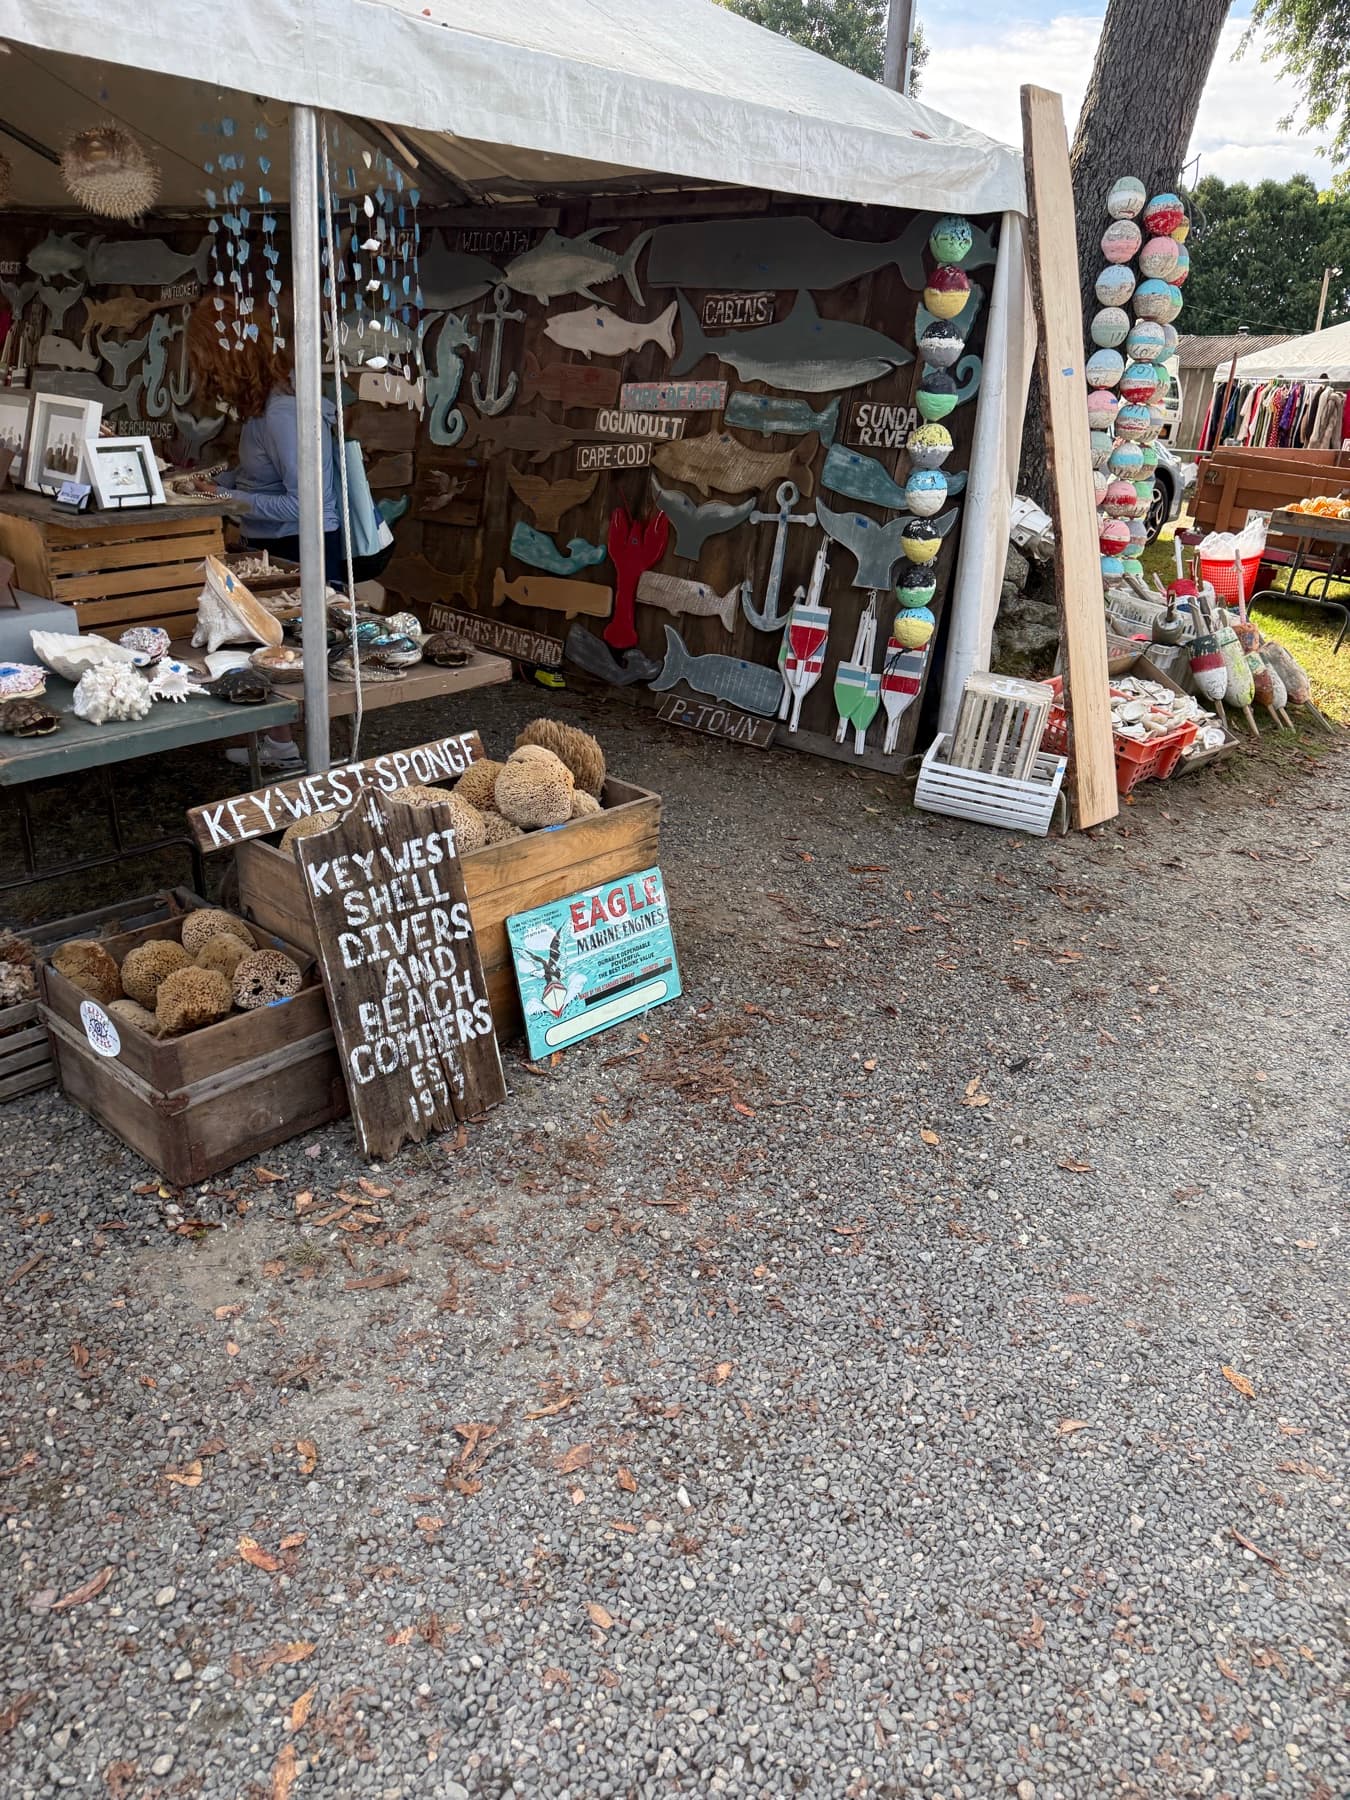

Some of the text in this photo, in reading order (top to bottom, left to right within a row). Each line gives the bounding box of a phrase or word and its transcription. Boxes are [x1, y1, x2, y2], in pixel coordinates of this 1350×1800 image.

[705, 297, 768, 324] CABINS
[598, 410, 684, 440] OGUNQUIT
[855, 403, 928, 431] SUNDA
[859, 427, 914, 449] RIVE
[580, 444, 646, 469] CAPE COD
[430, 608, 564, 666] MARTHA'S VINEYARD
[667, 698, 760, 742] P-TOWN
[202, 732, 476, 847] KEY WEST SPONGE
[307, 828, 457, 898] KEY WEST
[342, 868, 451, 927] SHELL
[570, 874, 661, 934] EAGLE
[338, 902, 473, 970] DIVERS
[385, 945, 457, 997] AND
[359, 969, 475, 1043] BEACH
[350, 998, 492, 1085] COMBERS
[408, 1073, 465, 1123] 1977
